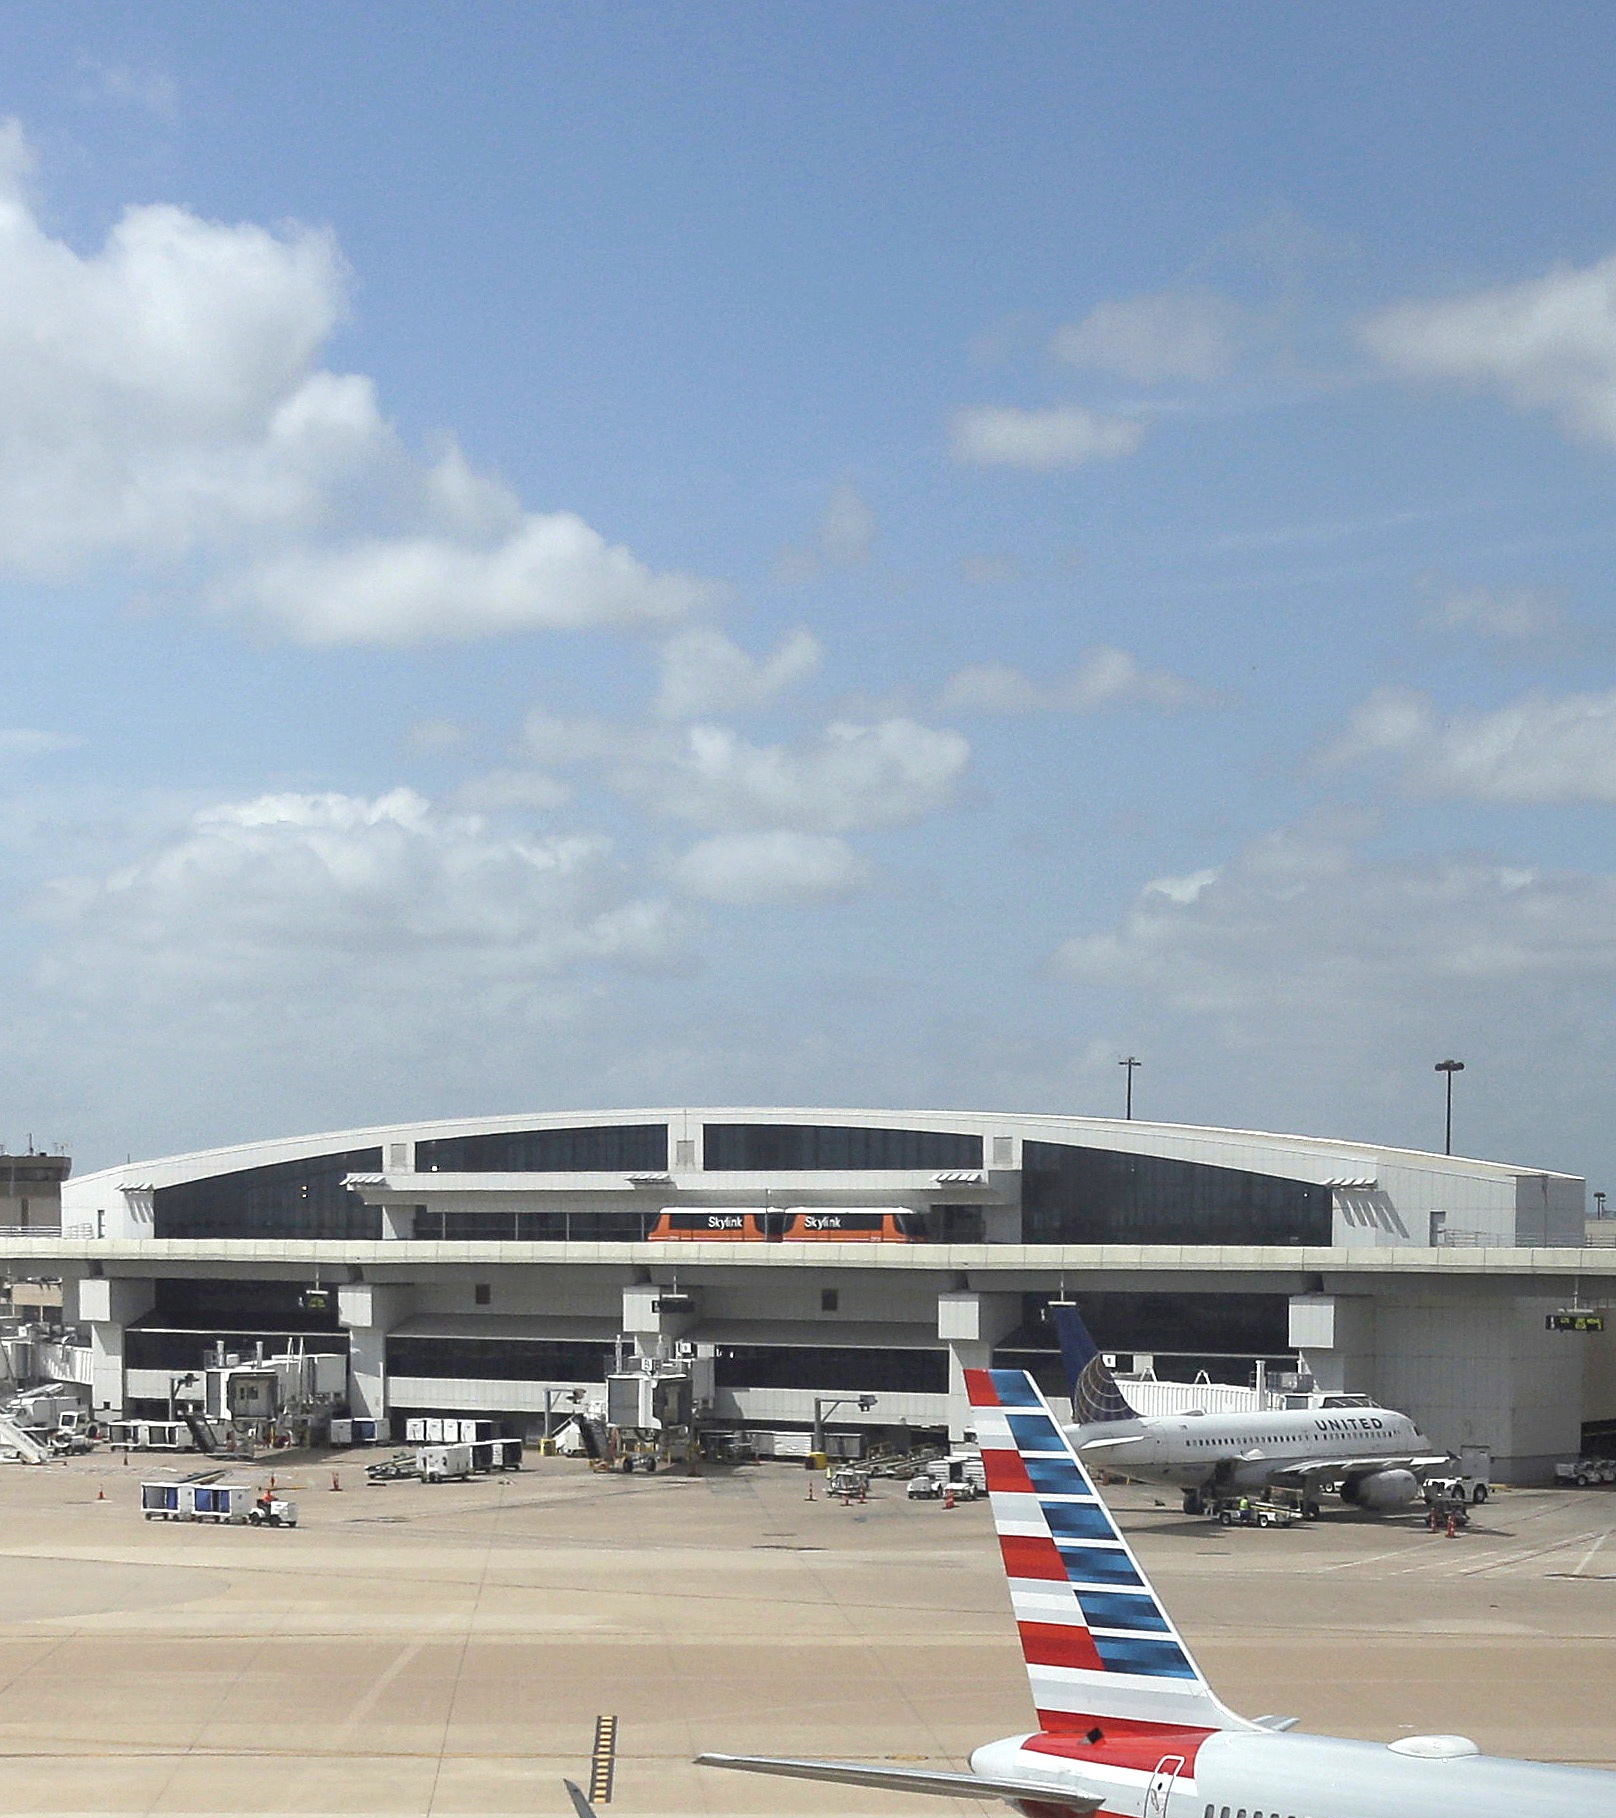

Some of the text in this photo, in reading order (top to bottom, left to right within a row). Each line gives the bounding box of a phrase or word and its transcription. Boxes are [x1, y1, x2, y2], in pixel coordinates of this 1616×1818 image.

[708, 1216, 743, 1230] Skylink
[804, 1216, 841, 1230] Skylink
[1315, 1418, 1383, 1431] UNITED
